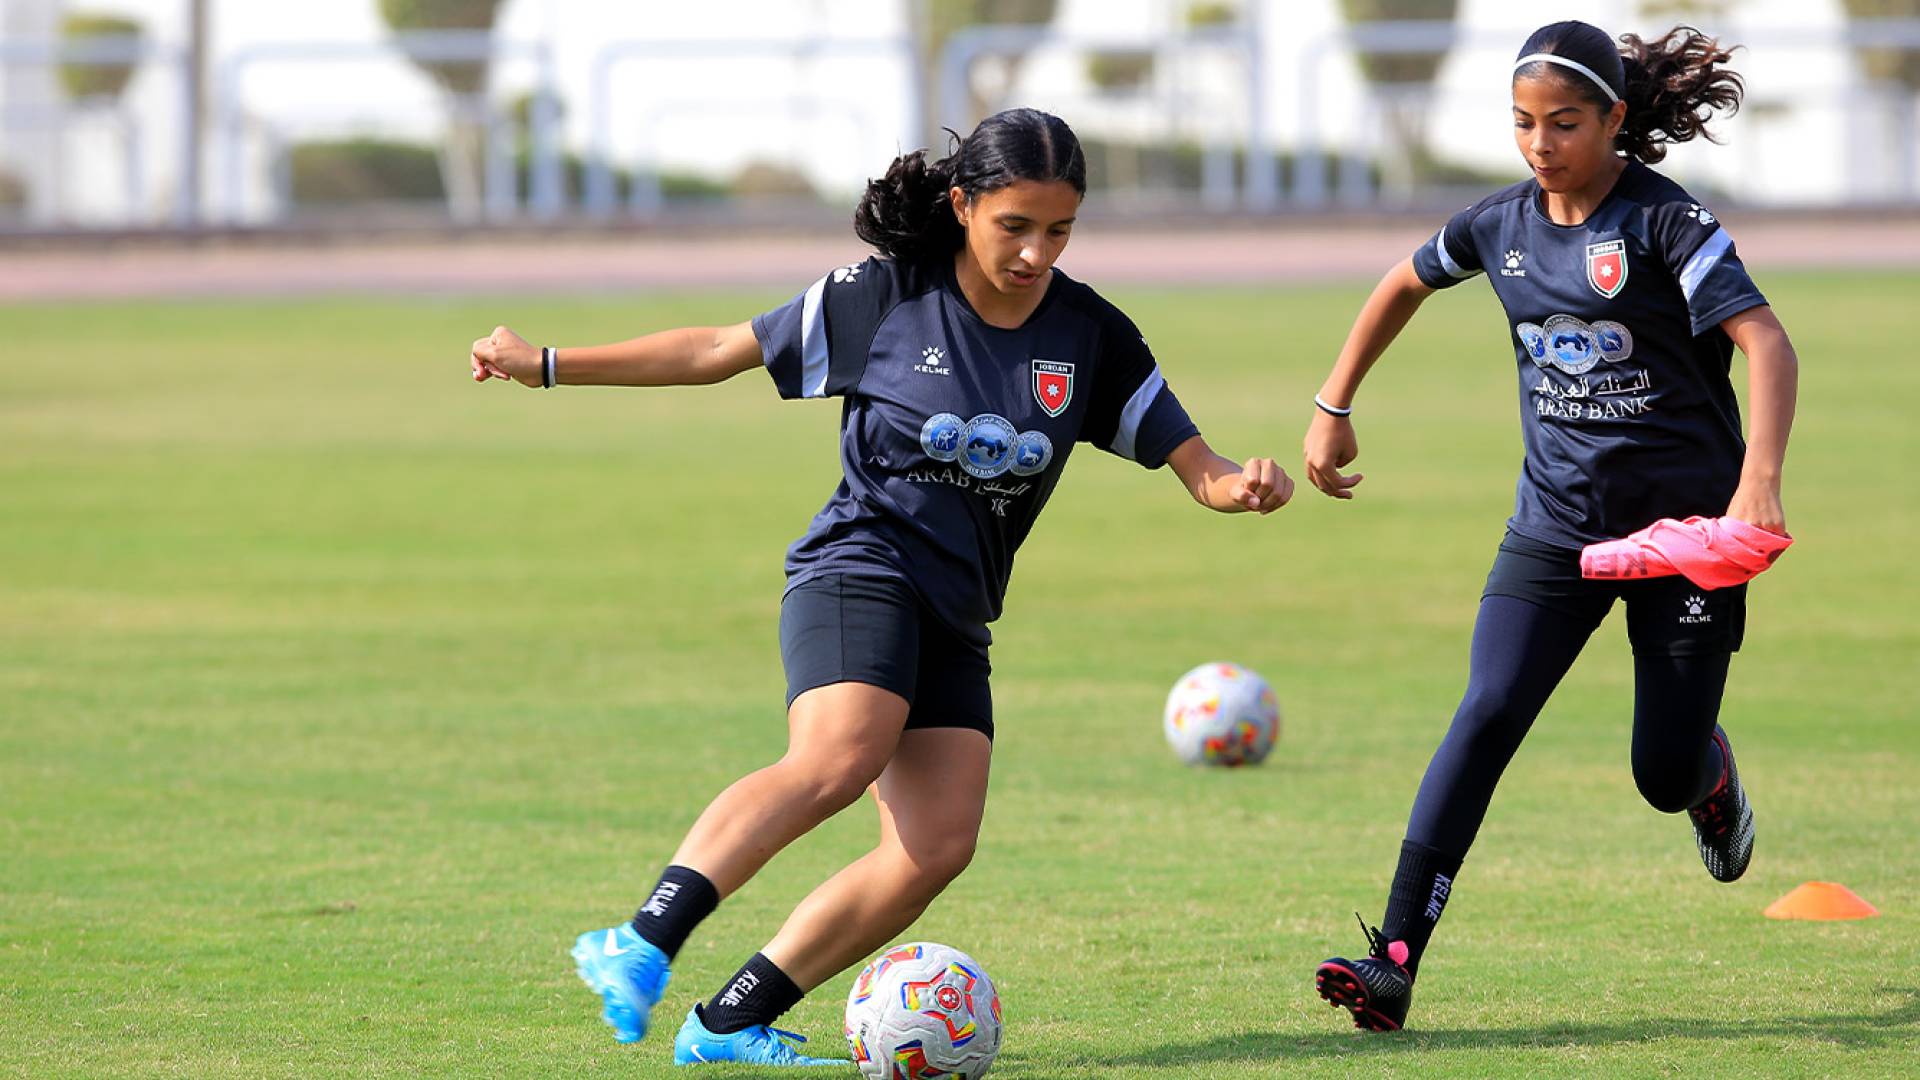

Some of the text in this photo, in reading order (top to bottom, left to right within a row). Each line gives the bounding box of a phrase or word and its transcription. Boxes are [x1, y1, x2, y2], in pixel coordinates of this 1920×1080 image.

[914, 364, 950, 375] KELME
[1038, 363, 1068, 373] JORDAN
[1536, 396, 1653, 419] ARAB BANK
[903, 467, 971, 488] ARAB
[1679, 614, 1712, 624] KELME
[1424, 872, 1451, 922] KELME
[719, 969, 761, 1007] KELME
